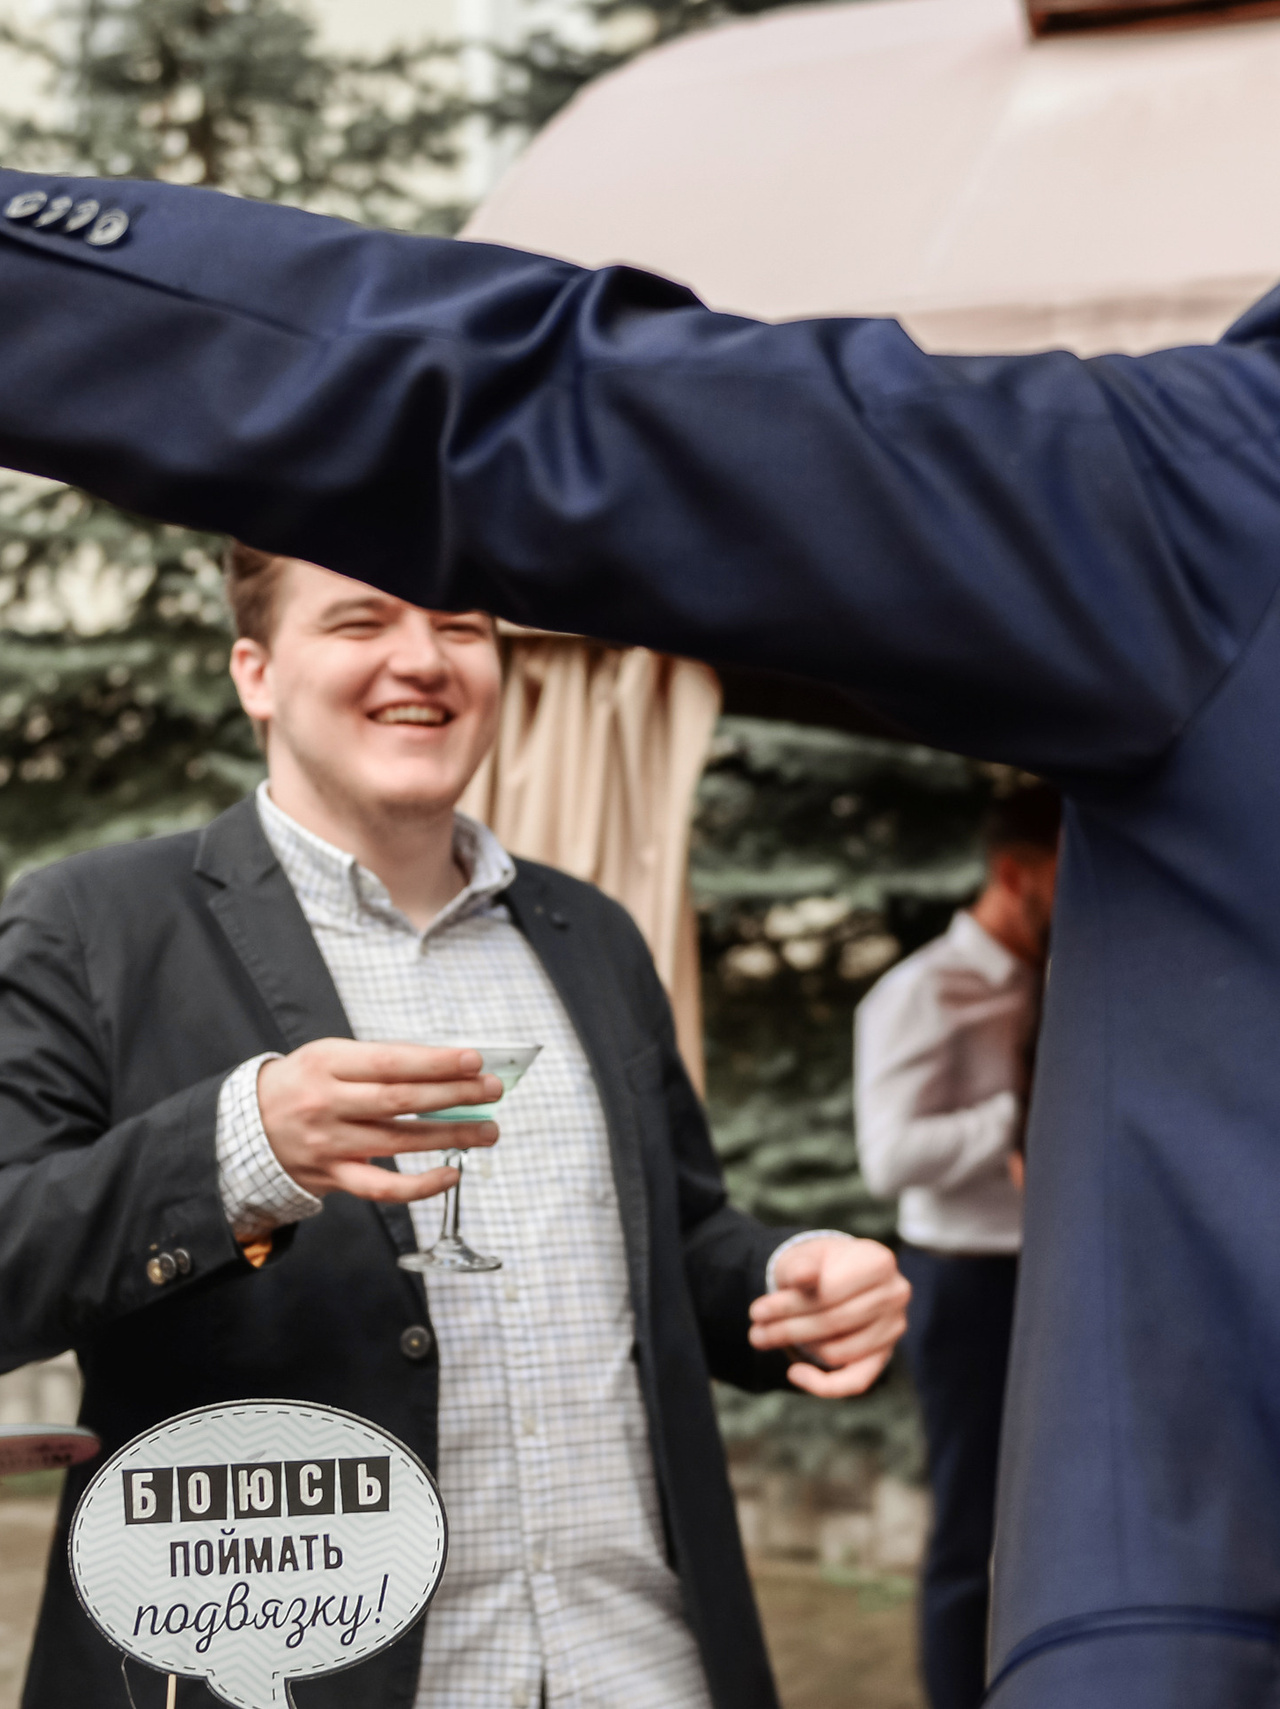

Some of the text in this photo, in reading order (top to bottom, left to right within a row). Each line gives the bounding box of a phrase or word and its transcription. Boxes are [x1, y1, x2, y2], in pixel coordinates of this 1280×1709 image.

[131, 1463, 382, 1520] БОЮСЬ
[169, 1528, 343, 1577] ПОЙМАТЬ
[133, 1574, 389, 1653] подвязку!
